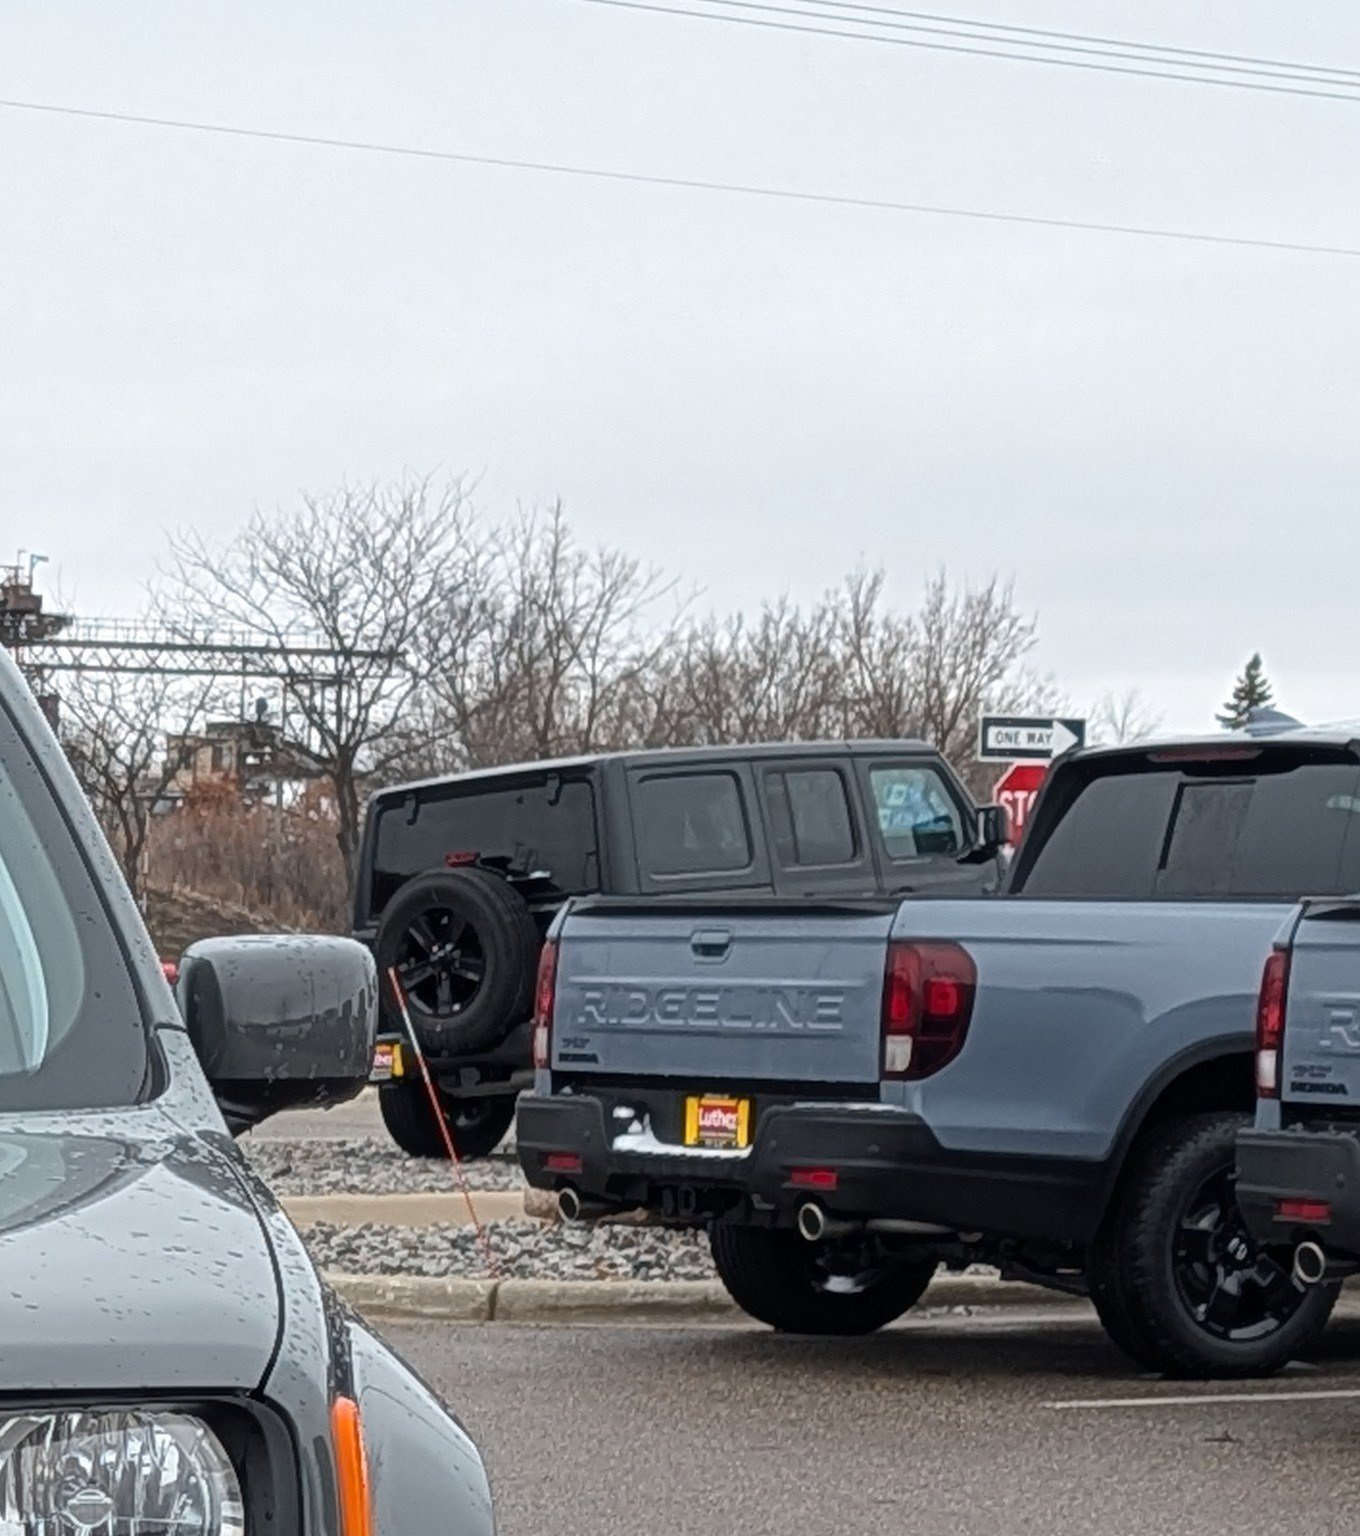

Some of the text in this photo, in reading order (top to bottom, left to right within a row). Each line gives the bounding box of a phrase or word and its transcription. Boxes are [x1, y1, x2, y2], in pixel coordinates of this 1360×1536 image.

[994, 731, 1053, 745] ONE WAY
[577, 988, 845, 1030] RIDGELINE
